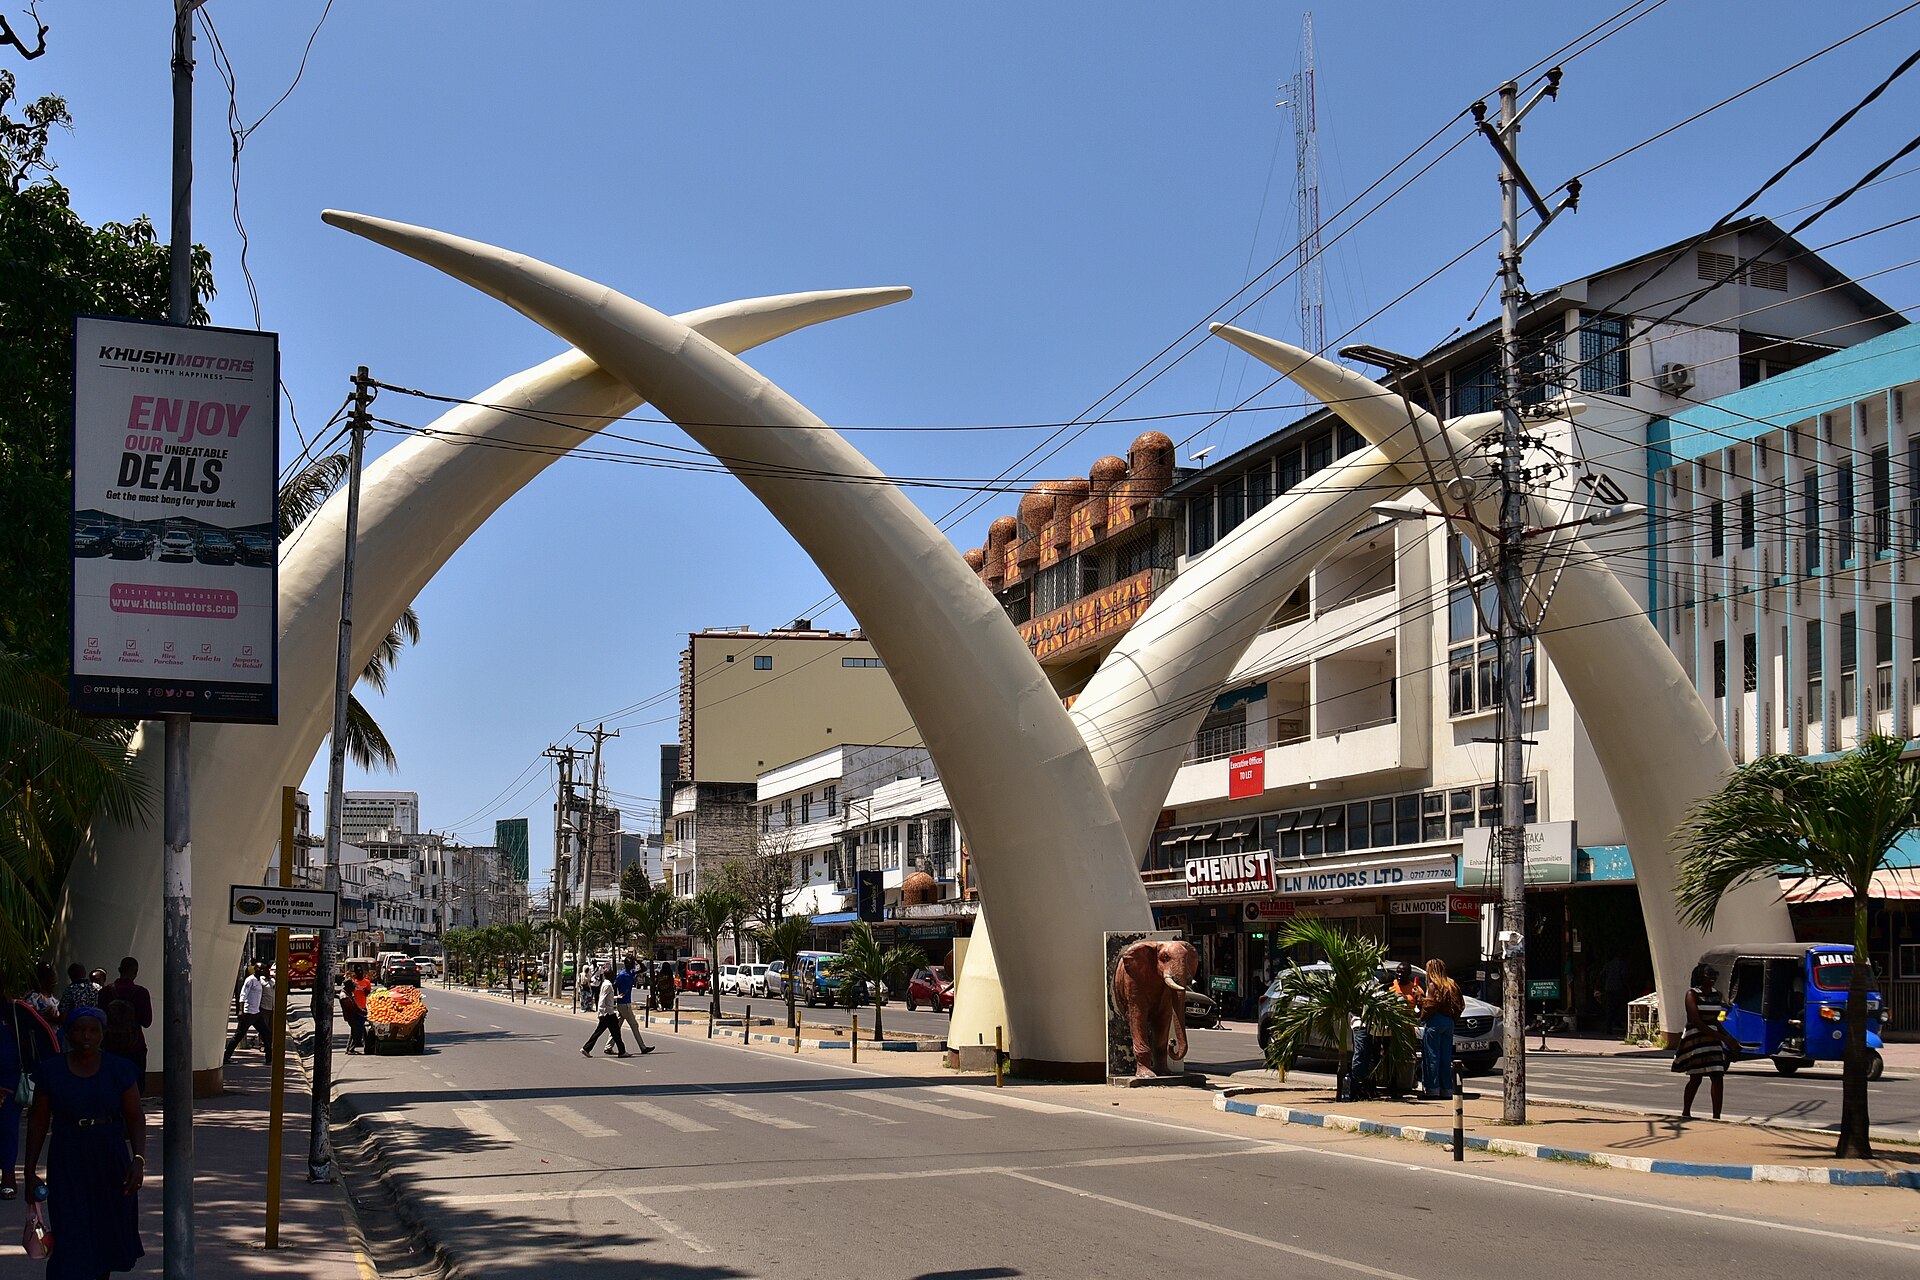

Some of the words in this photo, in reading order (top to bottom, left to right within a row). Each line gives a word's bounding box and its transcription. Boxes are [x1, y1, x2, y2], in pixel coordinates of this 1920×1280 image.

[154, 368, 175, 376] WITH
[179, 371, 224, 380] HAPPINESS
[127, 395, 251, 443] ENJOY
[124, 434, 164, 452] OUR
[164, 445, 228, 459] UNBEATABLE
[117, 452, 223, 494] DEALS
[106, 490, 121, 500] Get
[122, 491, 137, 502] the
[138, 493, 159, 503] most
[161, 495, 181, 506] bang
[182, 497, 195, 506] for
[196, 499, 215, 508] your
[216, 499, 236, 509] buck
[111, 598, 236, 614] www.khushimotors.com
[1239, 771, 1245, 780] TO
[1186, 853, 1268, 883] CHEMIST
[1190, 885, 1218, 896] DUKA
[1220, 883, 1235, 893] LA
[1236, 880, 1269, 892] DAWA
[1284, 877, 1301, 892] LN
[1308, 871, 1367, 890] MOTORS
[1373, 868, 1403, 884] LTD
[1410, 870, 1424, 880] 0717
[1426, 869, 1439, 878] 777
[267, 897, 289, 907] KENYA
[290, 900, 314, 908] URBAN
[1401, 902, 1411, 912] LN
[1412, 901, 1446, 912] MOTORS
[266, 908, 291, 918] ROADS
[292, 910, 331, 918] AUTHORITY
